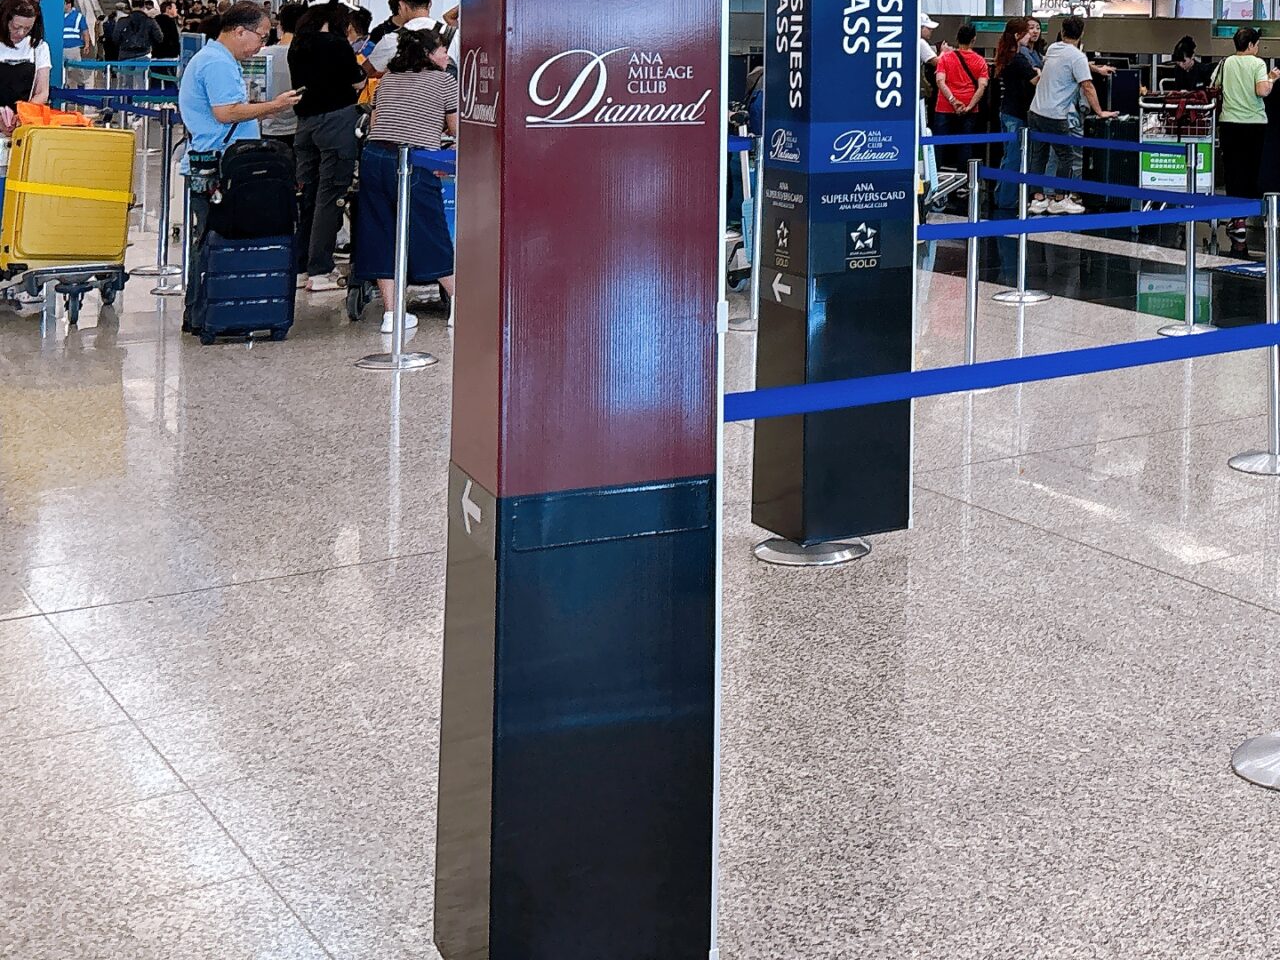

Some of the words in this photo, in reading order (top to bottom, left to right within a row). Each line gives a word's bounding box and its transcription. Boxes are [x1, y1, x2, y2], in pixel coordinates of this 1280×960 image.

[627, 52, 664, 66] ANA
[627, 66, 694, 80] MILEAGE
[526, 46, 712, 124] Diamond
[627, 80, 667, 94] CLUB
[830, 130, 900, 161] Platinum
[854, 182, 874, 193] ANA
[821, 194, 849, 205] SUPER
[850, 192, 879, 203] FLYERS
[880, 190, 906, 201] CARD
[849, 259, 877, 269] GOLD
